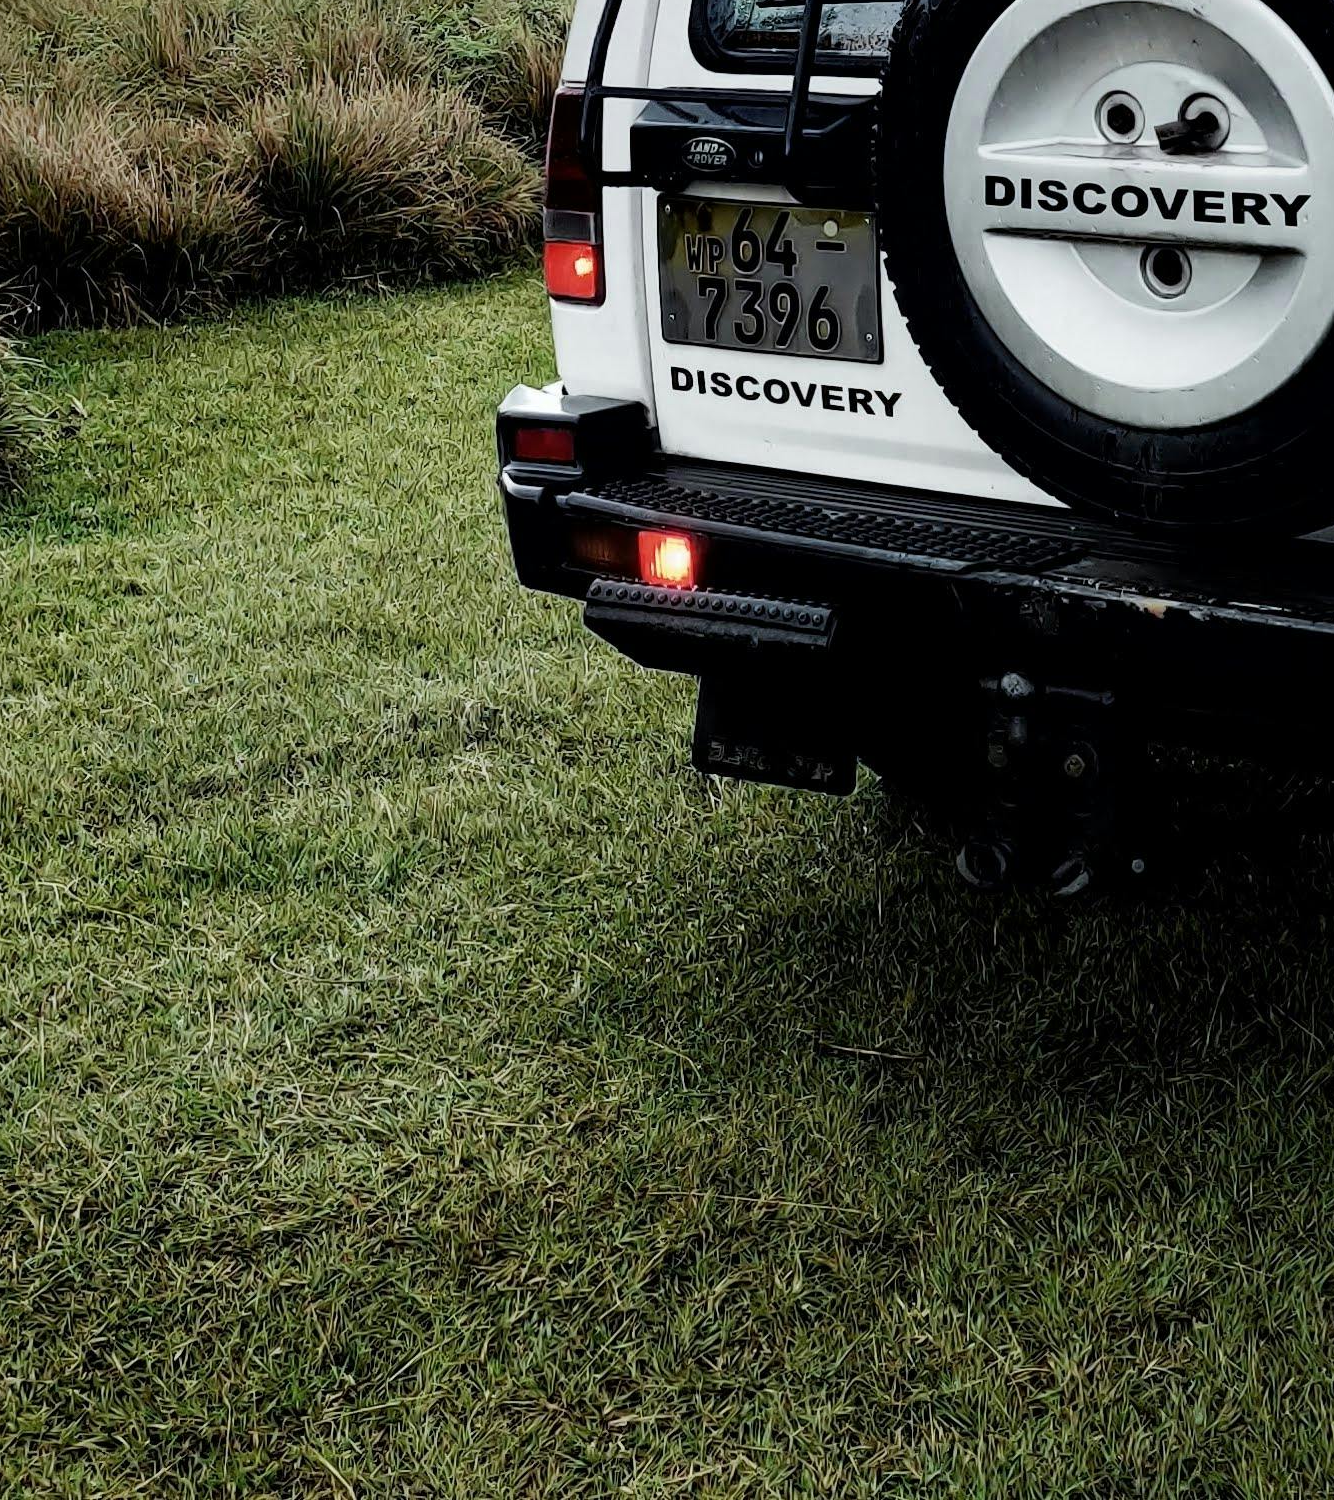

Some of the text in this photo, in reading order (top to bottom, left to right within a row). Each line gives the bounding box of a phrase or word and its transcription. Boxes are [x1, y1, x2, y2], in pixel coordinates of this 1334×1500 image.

[983, 175, 1312, 228] DISCOVERY
[684, 233, 725, 274] WP
[697, 275, 842, 353] 7396
[669, 365, 903, 418] DISCOVERY
